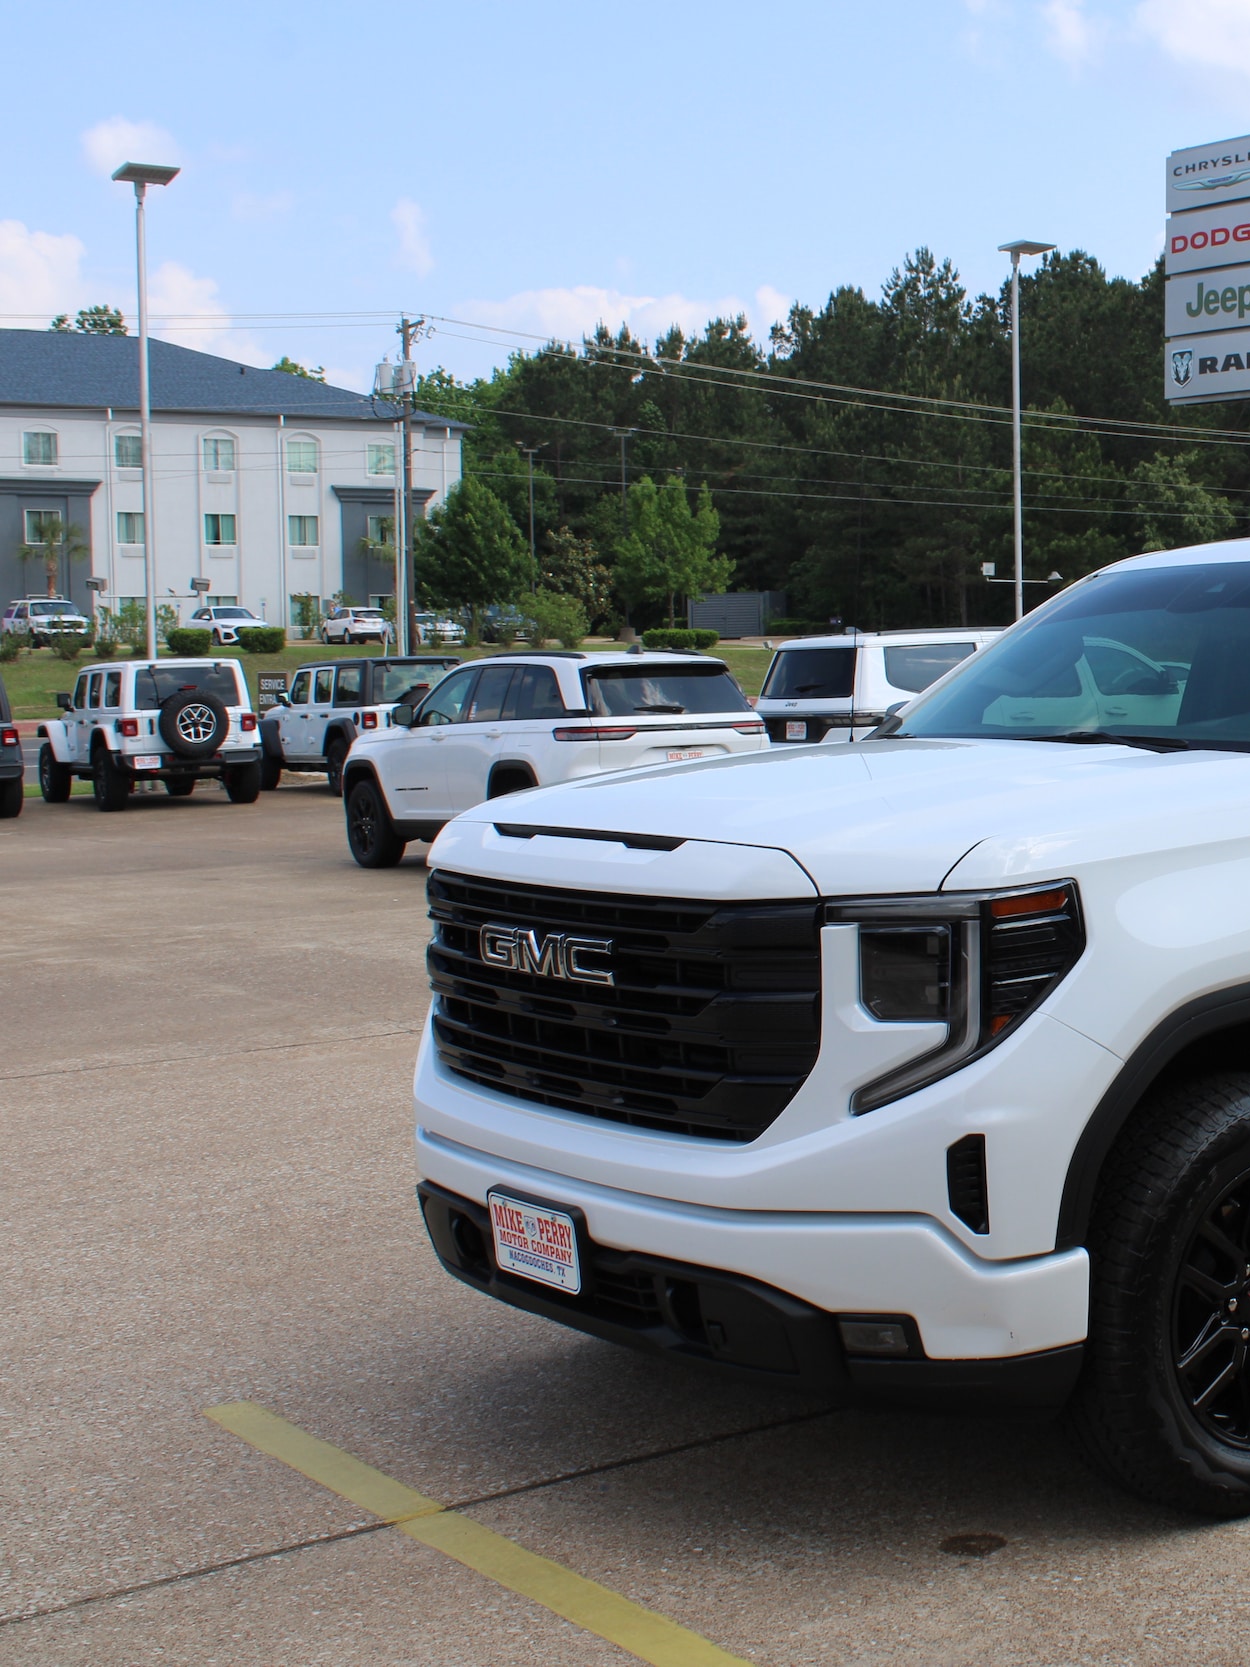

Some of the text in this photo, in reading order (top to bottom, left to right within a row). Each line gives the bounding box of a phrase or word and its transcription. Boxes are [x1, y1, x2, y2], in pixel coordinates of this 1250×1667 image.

[260, 678, 285, 690] SERVICE
[480, 924, 615, 986] GMC
[493, 1203, 572, 1250] MIKE PERRY
[500, 1229, 572, 1264] MOTOR COMPANY
[556, 1266, 566, 1277] TX
